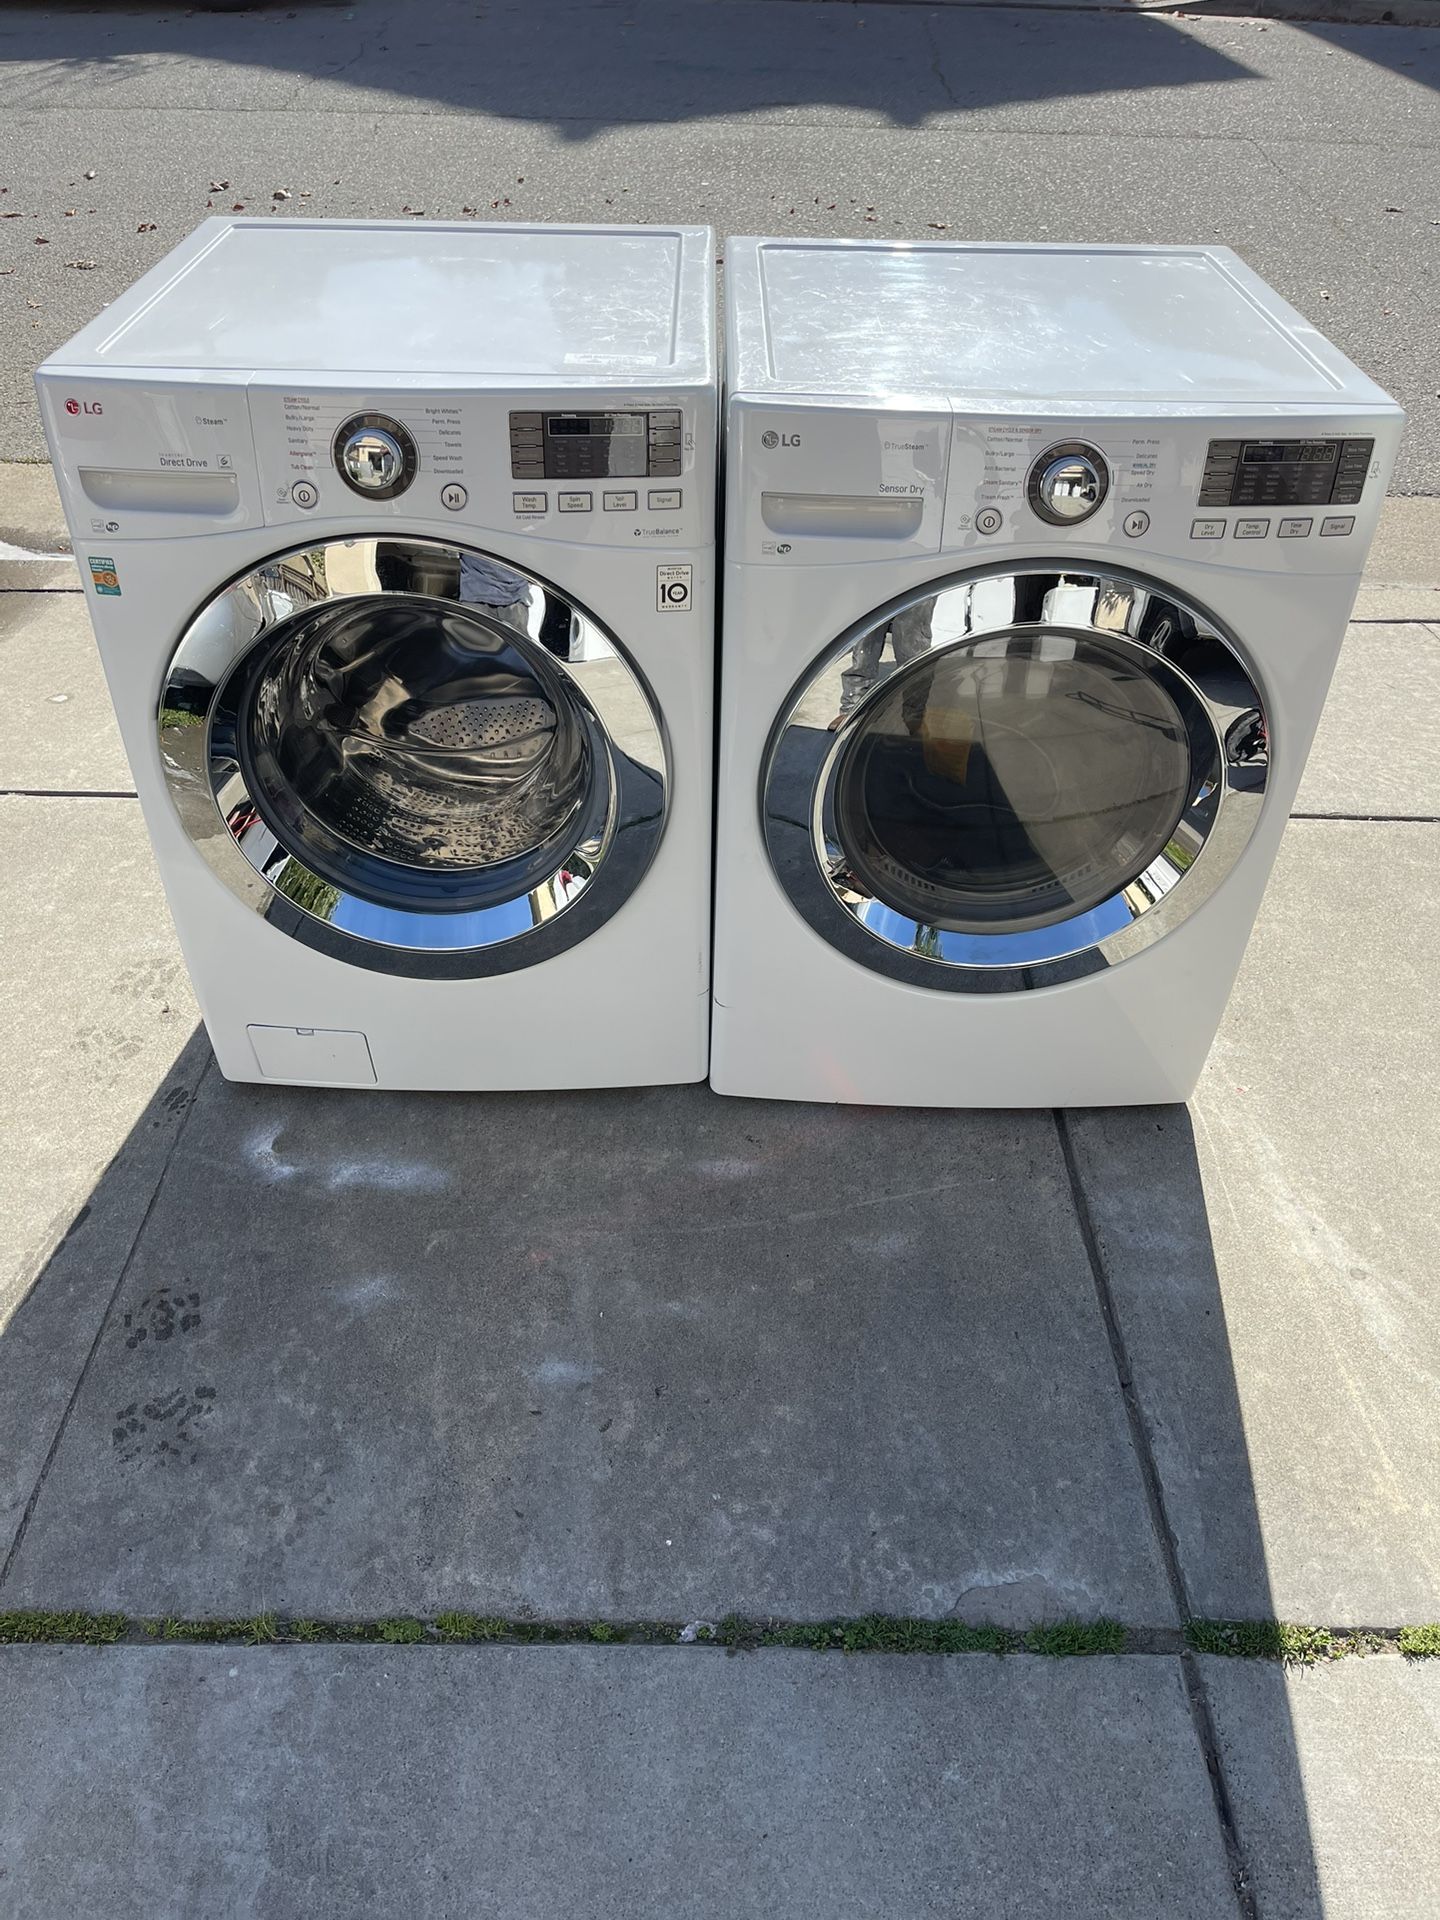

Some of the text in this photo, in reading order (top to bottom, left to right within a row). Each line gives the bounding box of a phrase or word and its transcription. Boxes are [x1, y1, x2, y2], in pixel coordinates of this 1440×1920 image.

[84, 402, 103, 415] LG
[782, 434, 801, 447] LG
[160, 457, 208, 468] Direct Drive
[879, 484, 925, 496] Sensor Dry
[656, 496, 672, 504] Signal
[642, 528, 680, 536] TrueBalance
[660, 583, 688, 603] 10
